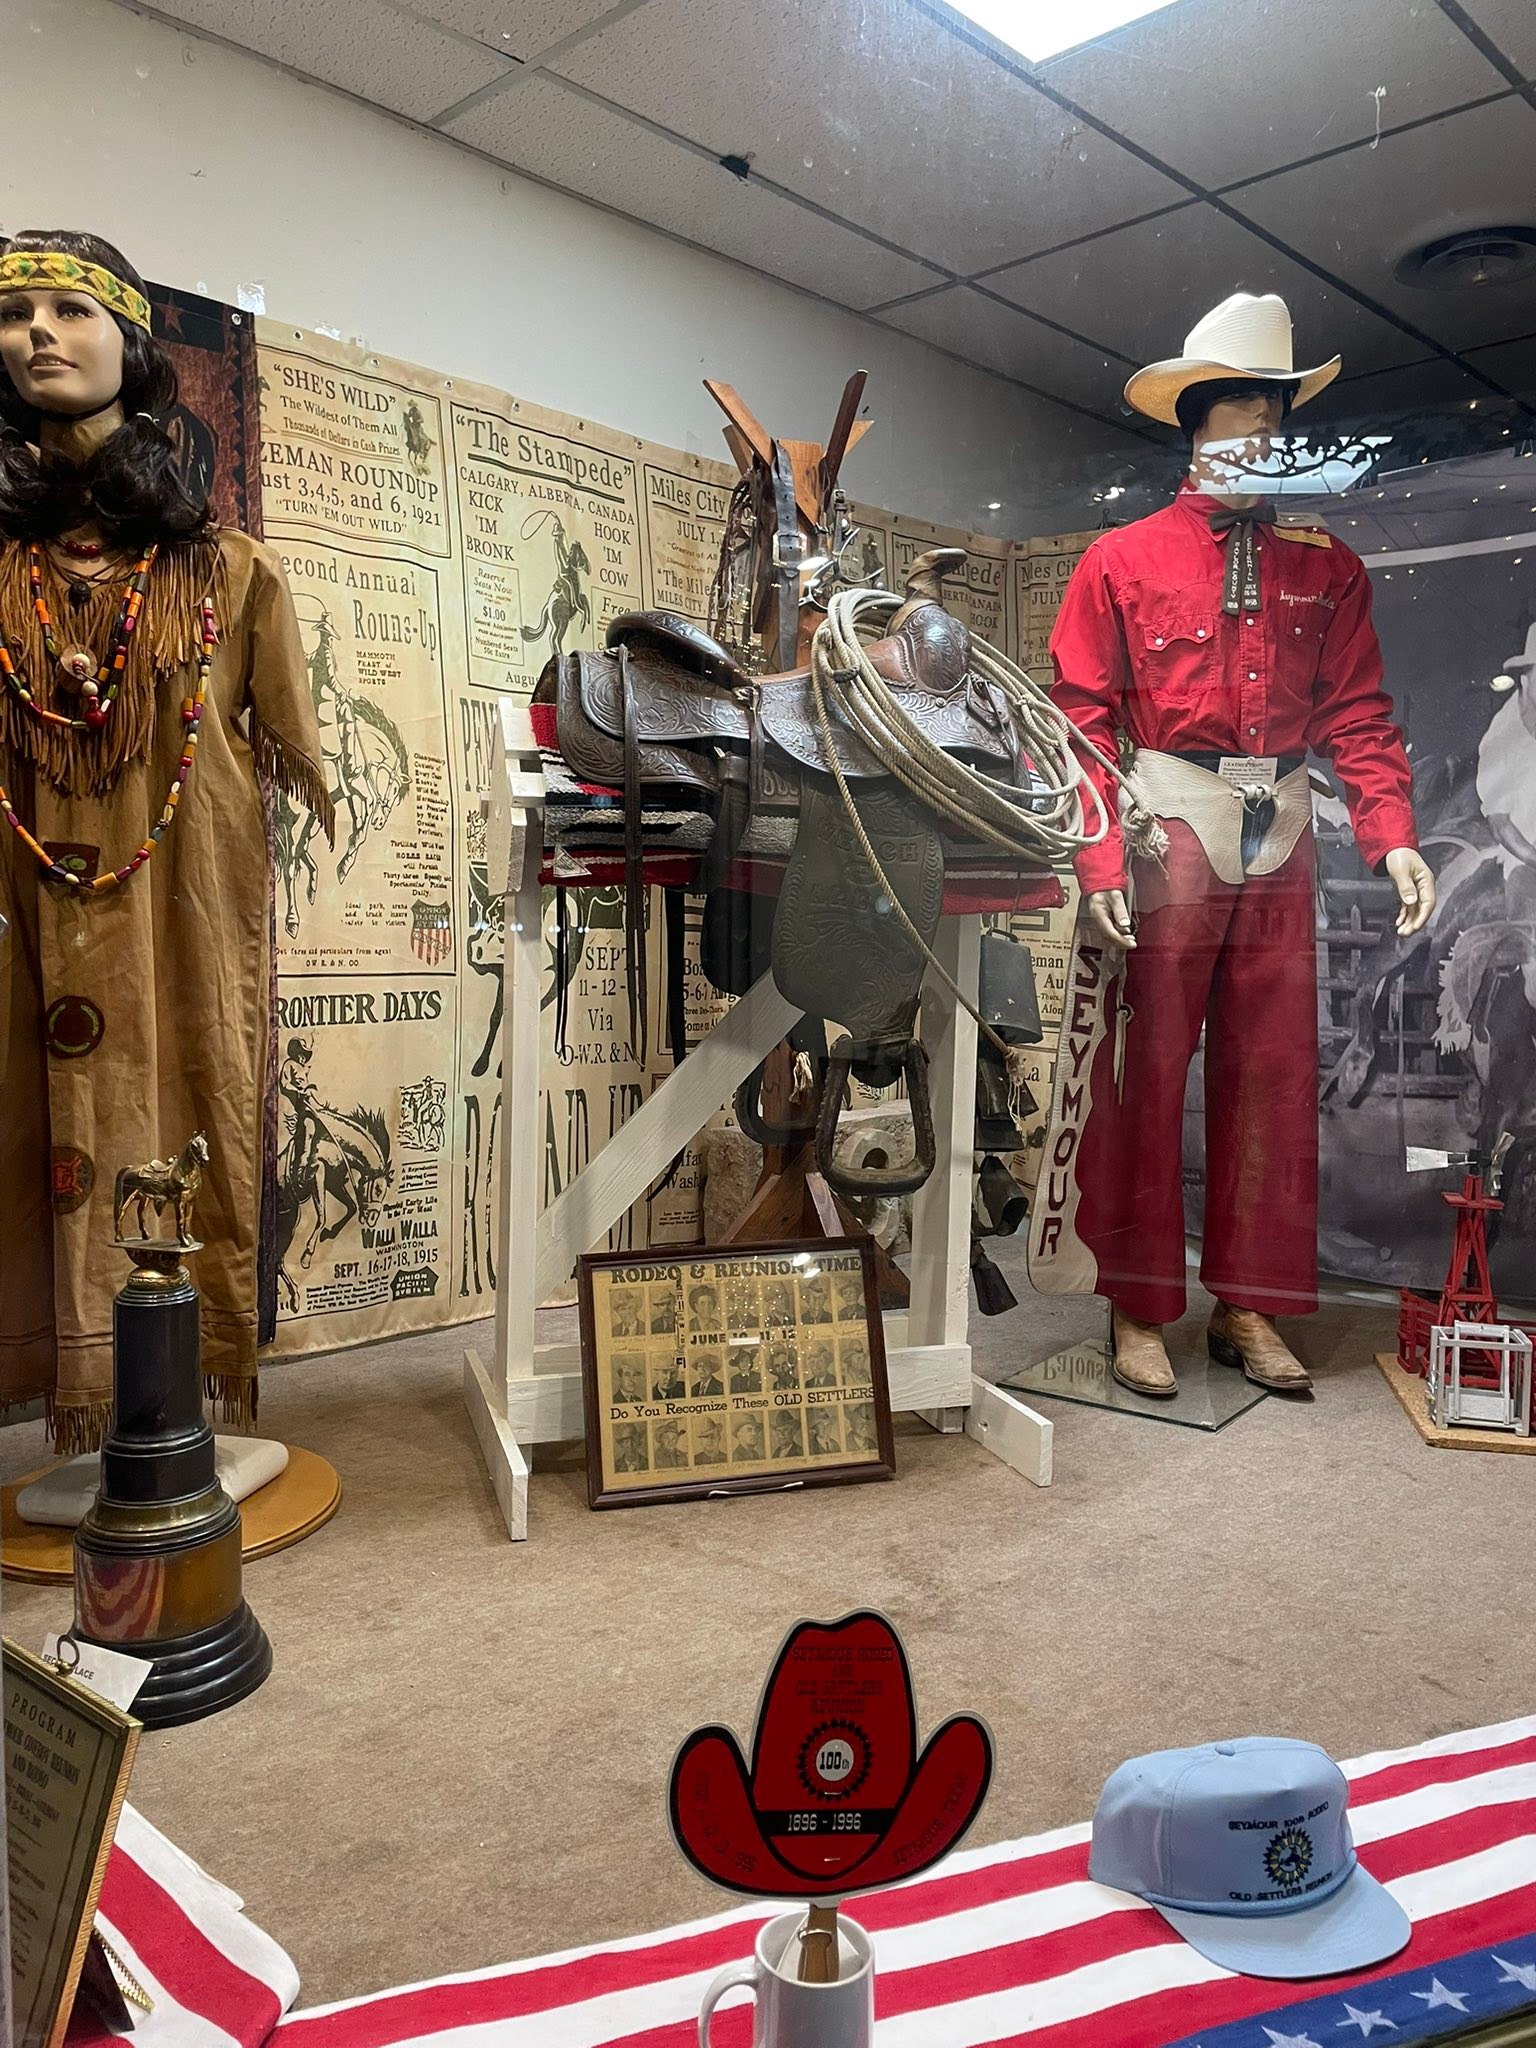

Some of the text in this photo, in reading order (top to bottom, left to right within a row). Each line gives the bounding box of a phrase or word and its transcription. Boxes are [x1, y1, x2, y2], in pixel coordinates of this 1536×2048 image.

[280, 395, 398, 436] The Wildest of Them All
[284, 417, 319, 436] Thousands
[328, 429, 350, 447] Dollars
[352, 435, 360, 449] in
[360, 438, 376, 454] Cash
[379, 443, 400, 456] Prizes
[518, 435, 632, 490] Stampede”
[340, 460, 439, 503] ROUNDUP
[460, 466, 524, 497] CALGARY,
[588, 501, 636, 526] CANADA
[468, 490, 504, 514] KICK
[650, 474, 726, 519] Miles City
[342, 512, 365, 530] OUT
[350, 492, 383, 512] and
[412, 504, 441, 527] 1921
[594, 522, 631, 545] HOOK
[676, 520, 706, 545] JULY
[465, 534, 515, 561] BRONK
[600, 570, 629, 588] COW
[657, 589, 684, 608] MILES
[483, 606, 506, 622] $1.00
[356, 650, 396, 661] MAMMOTH
[358, 668, 402, 678] WILD WEST
[383, 990, 443, 1023] DAYS
[588, 1008, 613, 1031] Via
[610, 1042, 620, 1063] &
[1038, 944, 1102, 1257] SEYMOUR
[361, 1219, 438, 1249] WALLA WALLA
[376, 1241, 424, 1256] WASHINGTON
[334, 1248, 438, 1278] SEPT. 16-17-18, 1915
[611, 1256, 862, 1284] RODEO & REUNION TIME
[399, 1273, 428, 1281] UNION
[690, 1333, 726, 1345] JUNE
[610, 1387, 875, 1420] Do You Recognize These OLD SETTLERS
[11, 1692, 77, 1748] PROGRAM
[819, 1751, 850, 1770] 100th
[788, 1812, 862, 1832] 1896 1996
[1229, 1820, 1278, 1831] SEYMOUR
[1307, 1801, 1329, 1820] RODEO
[1229, 1891, 1252, 1902] OLD
[1257, 1886, 1303, 1901] SETTLERS
